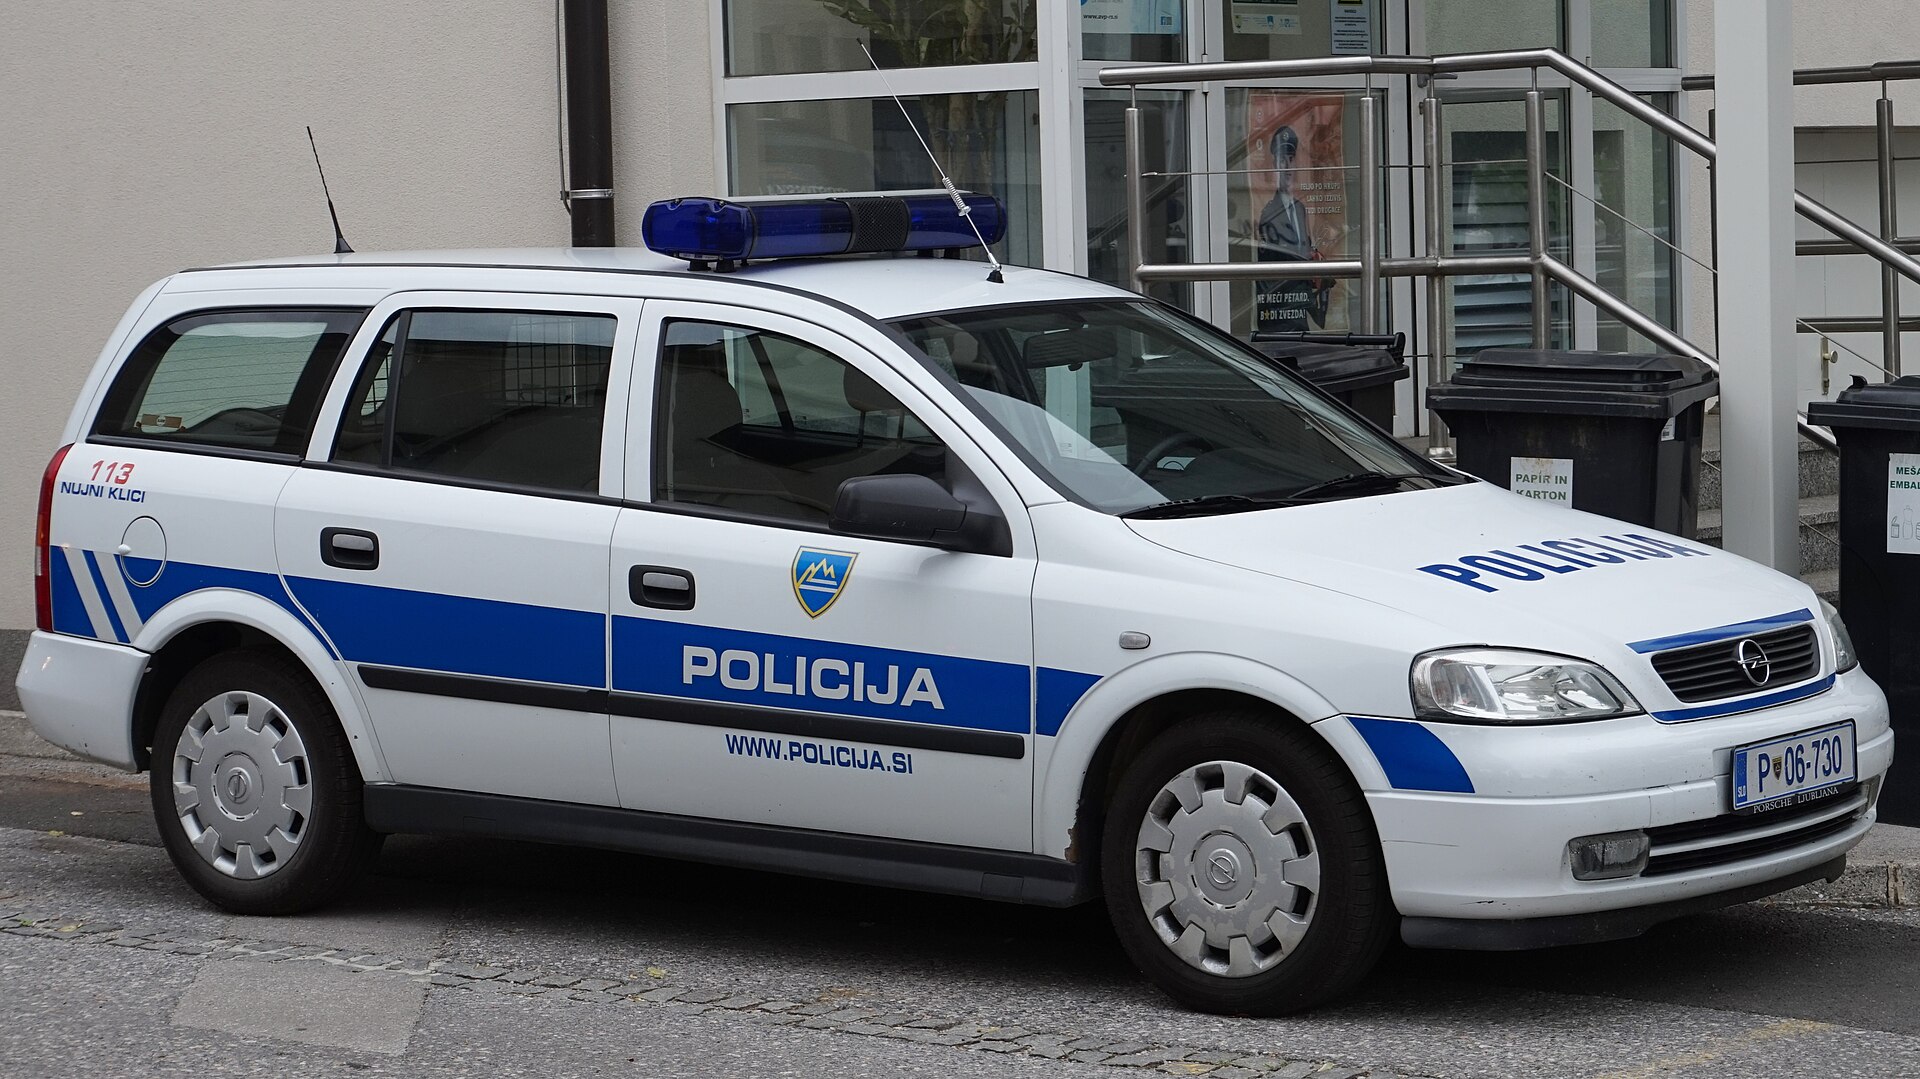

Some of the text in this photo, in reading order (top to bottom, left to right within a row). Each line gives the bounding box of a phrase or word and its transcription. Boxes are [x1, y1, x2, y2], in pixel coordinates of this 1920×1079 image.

[1257, 292, 1310, 303] NE MEČI PETARD.
[1279, 309, 1306, 320] ZVEZDA!
[91, 460, 135, 485] 113
[1515, 473, 1568, 485] PAPIR IN
[60, 481, 146, 503] NUJNI KLICI
[1416, 534, 1711, 593] POLICIJA
[682, 645, 945, 710] POLICIJA
[725, 733, 913, 774] WWW.POLICIJA.SI
[1758, 735, 1842, 793] P 06-730
[1737, 785, 1746, 798] SLO
[1753, 786, 1839, 814] PORSCHE LJUBLJANA
